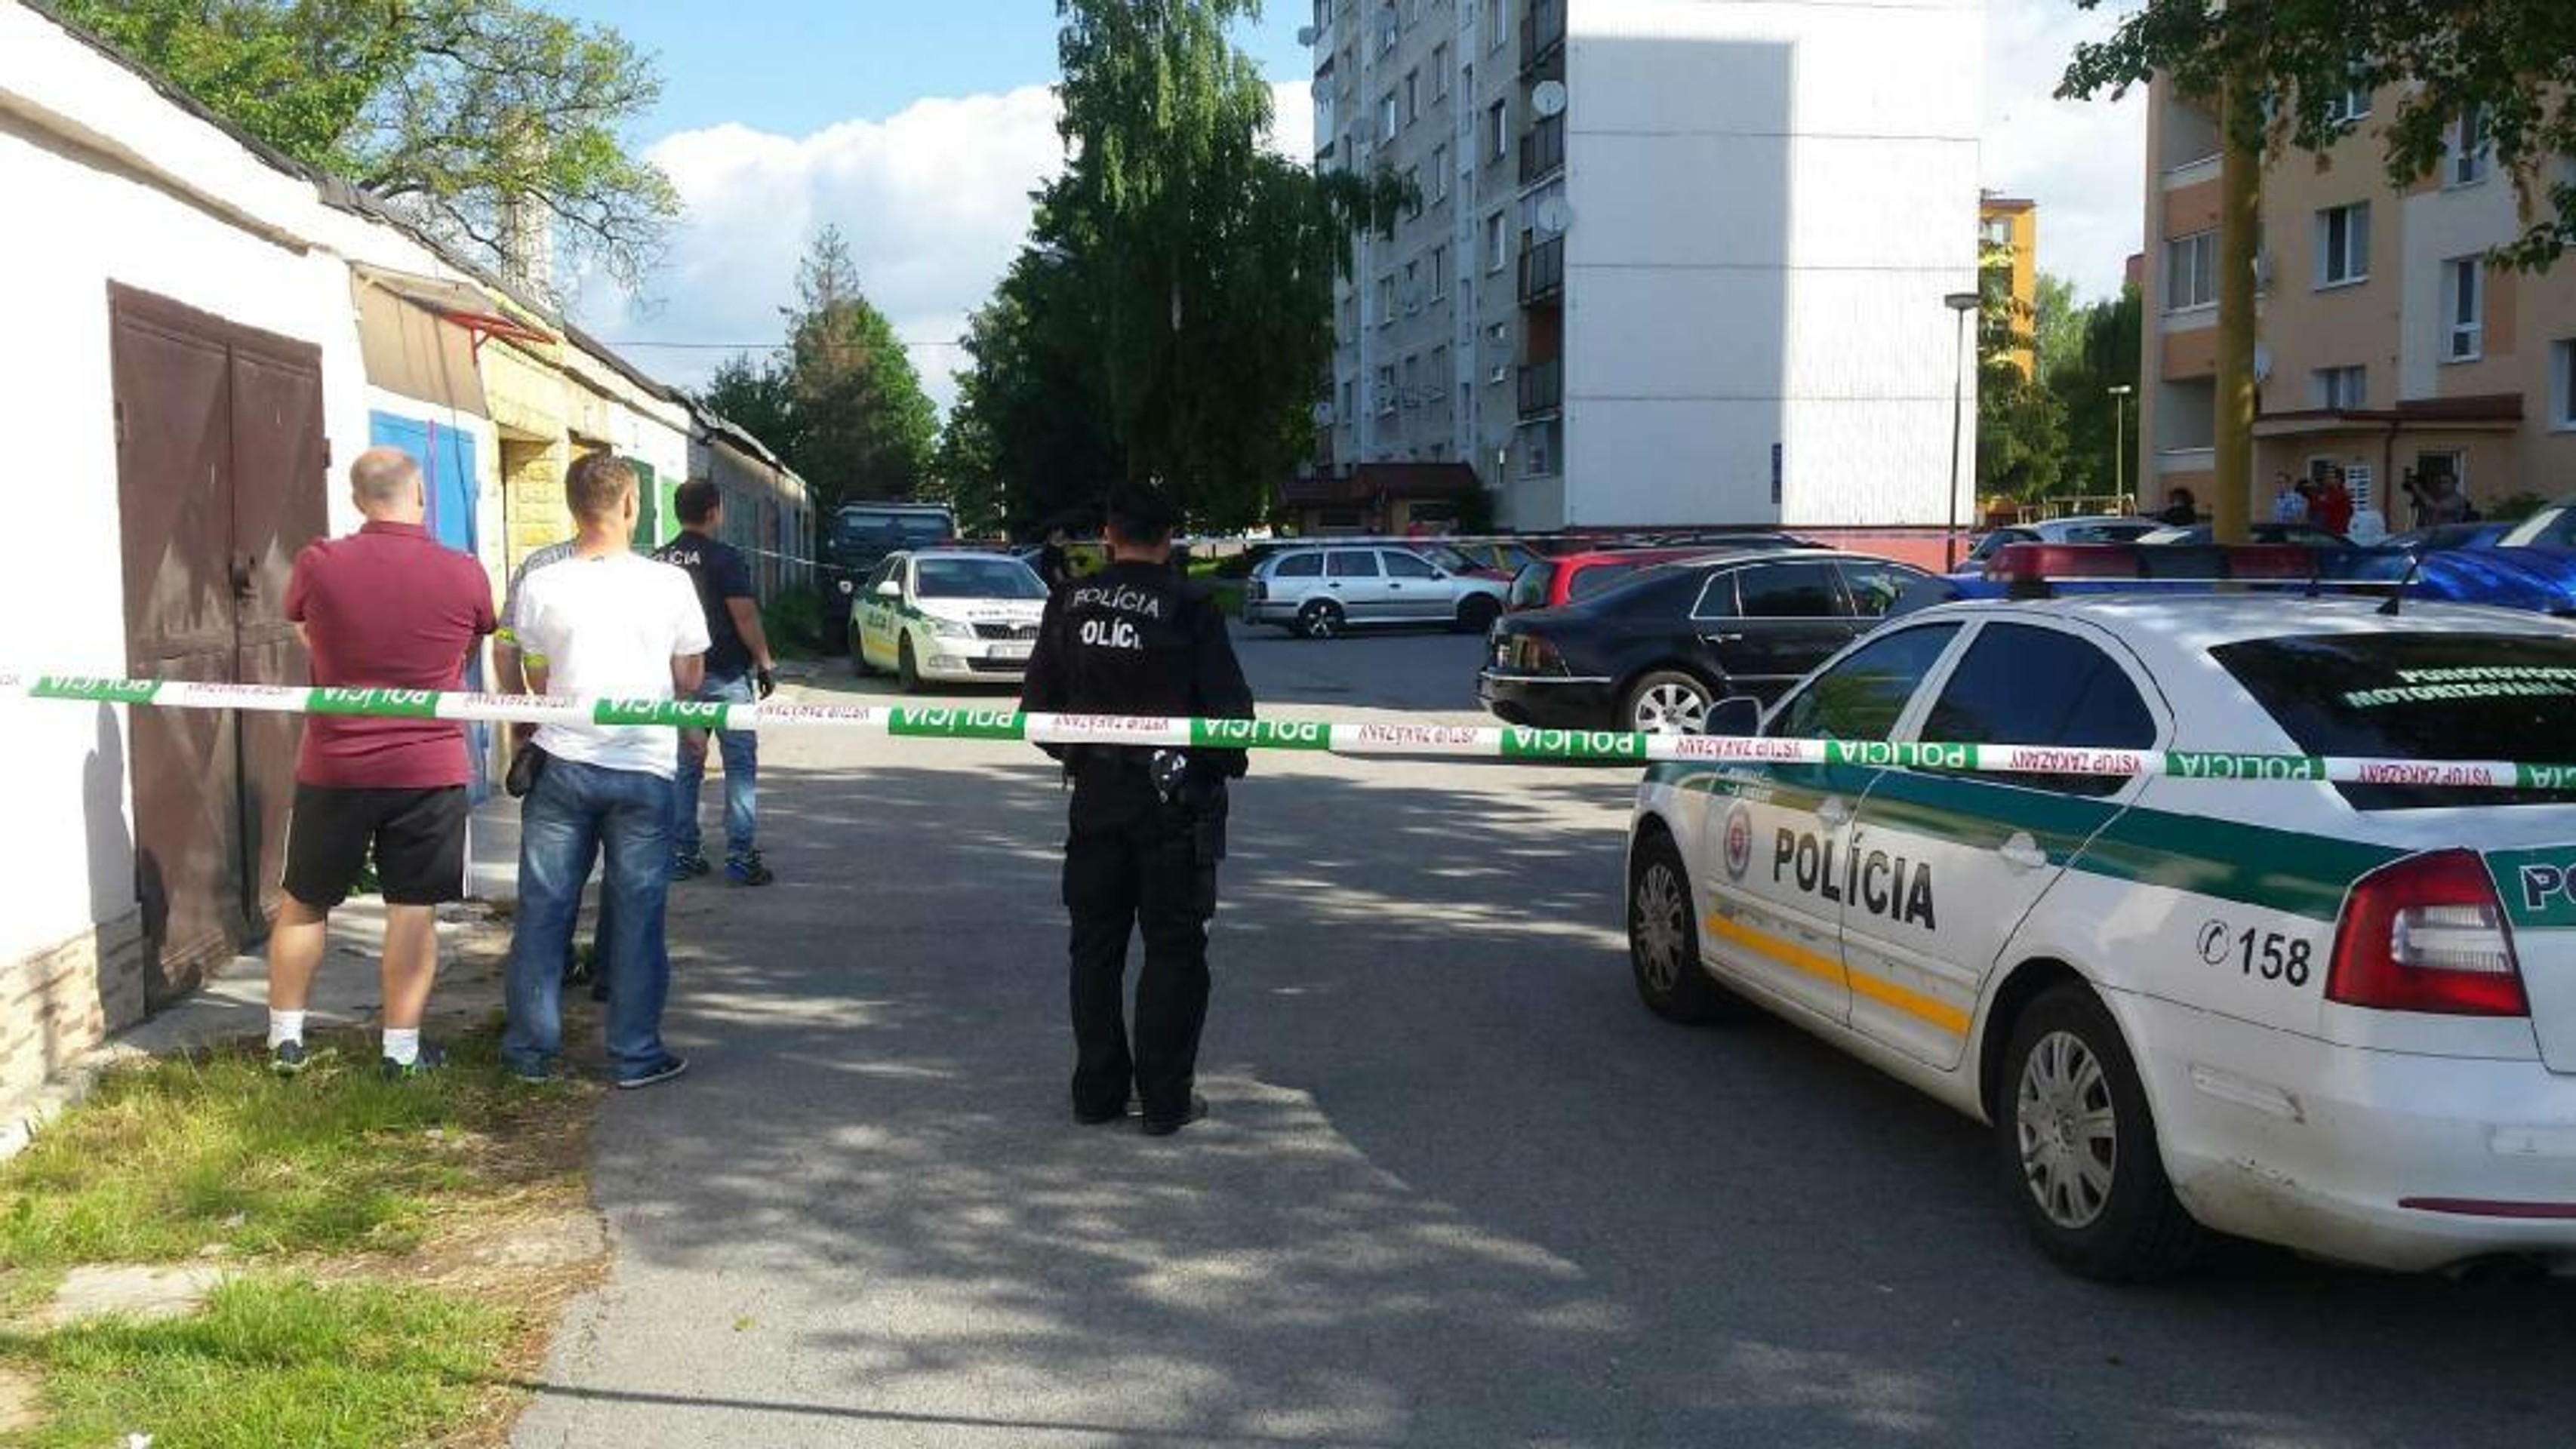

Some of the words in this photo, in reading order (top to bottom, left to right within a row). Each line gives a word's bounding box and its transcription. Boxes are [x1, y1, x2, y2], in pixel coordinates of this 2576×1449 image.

[2092, 753, 2142, 774] VSTUP
[1774, 827, 1936, 931] POLÍCIA
[2239, 927, 2310, 987] 158
